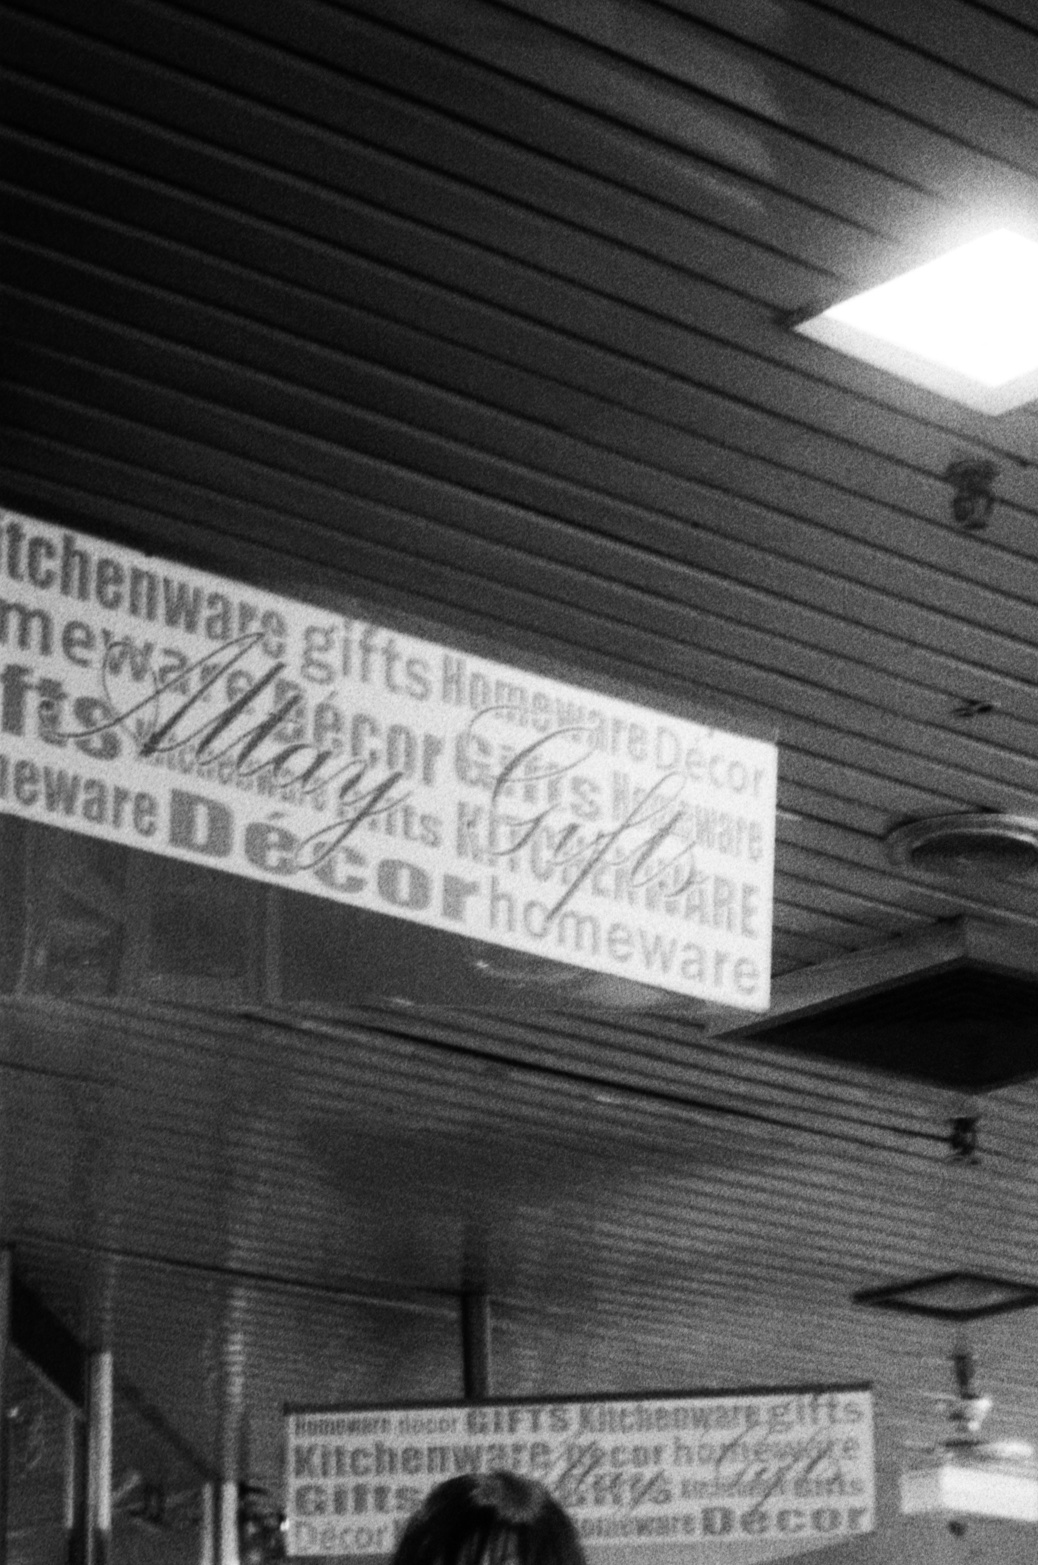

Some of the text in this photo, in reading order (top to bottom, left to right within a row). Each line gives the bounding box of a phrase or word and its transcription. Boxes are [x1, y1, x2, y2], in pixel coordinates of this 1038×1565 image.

[300, 616, 434, 700] gifts
[168, 786, 479, 923] Décor
[489, 873, 762, 996] homeware
[294, 1440, 551, 1477] Kitchenware
